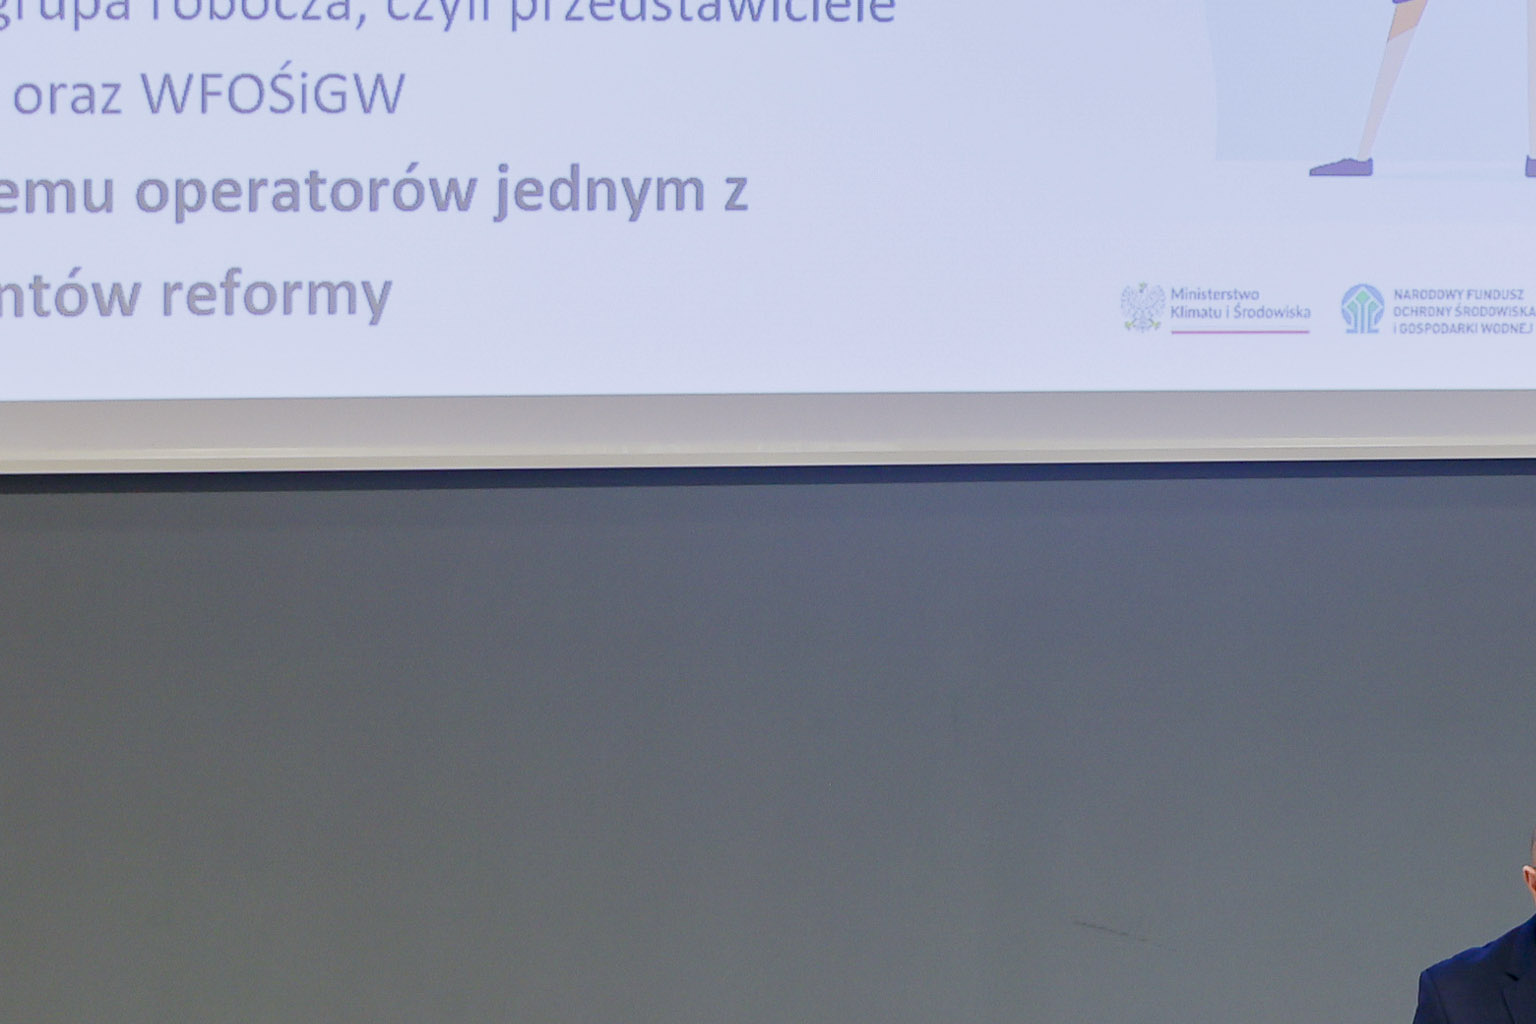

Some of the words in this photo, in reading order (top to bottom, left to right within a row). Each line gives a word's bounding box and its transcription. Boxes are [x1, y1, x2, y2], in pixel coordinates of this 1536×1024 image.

[13, 81, 122, 115] oraz
[140, 60, 406, 115] WFOŚiGW
[0, 178, 113, 214] emu
[136, 162, 477, 224] operatorów
[493, 163, 706, 223] jednym
[725, 175, 749, 212] z
[163, 267, 393, 326] reformy
[1171, 287, 1260, 301] Ministerstwo
[1393, 288, 1464, 301] NARODOWY
[1466, 288, 1525, 301] FUNDUSZ
[1170, 304, 1223, 320] Klimatu
[1233, 302, 1312, 320] Środowiska
[1393, 305, 1452, 317] OCHRONY
[1454, 302, 1536, 317] ŚRODOWISKA
[1399, 322, 1479, 335] GOSPODARKI
[1480, 322, 1534, 335] WODNEJ
